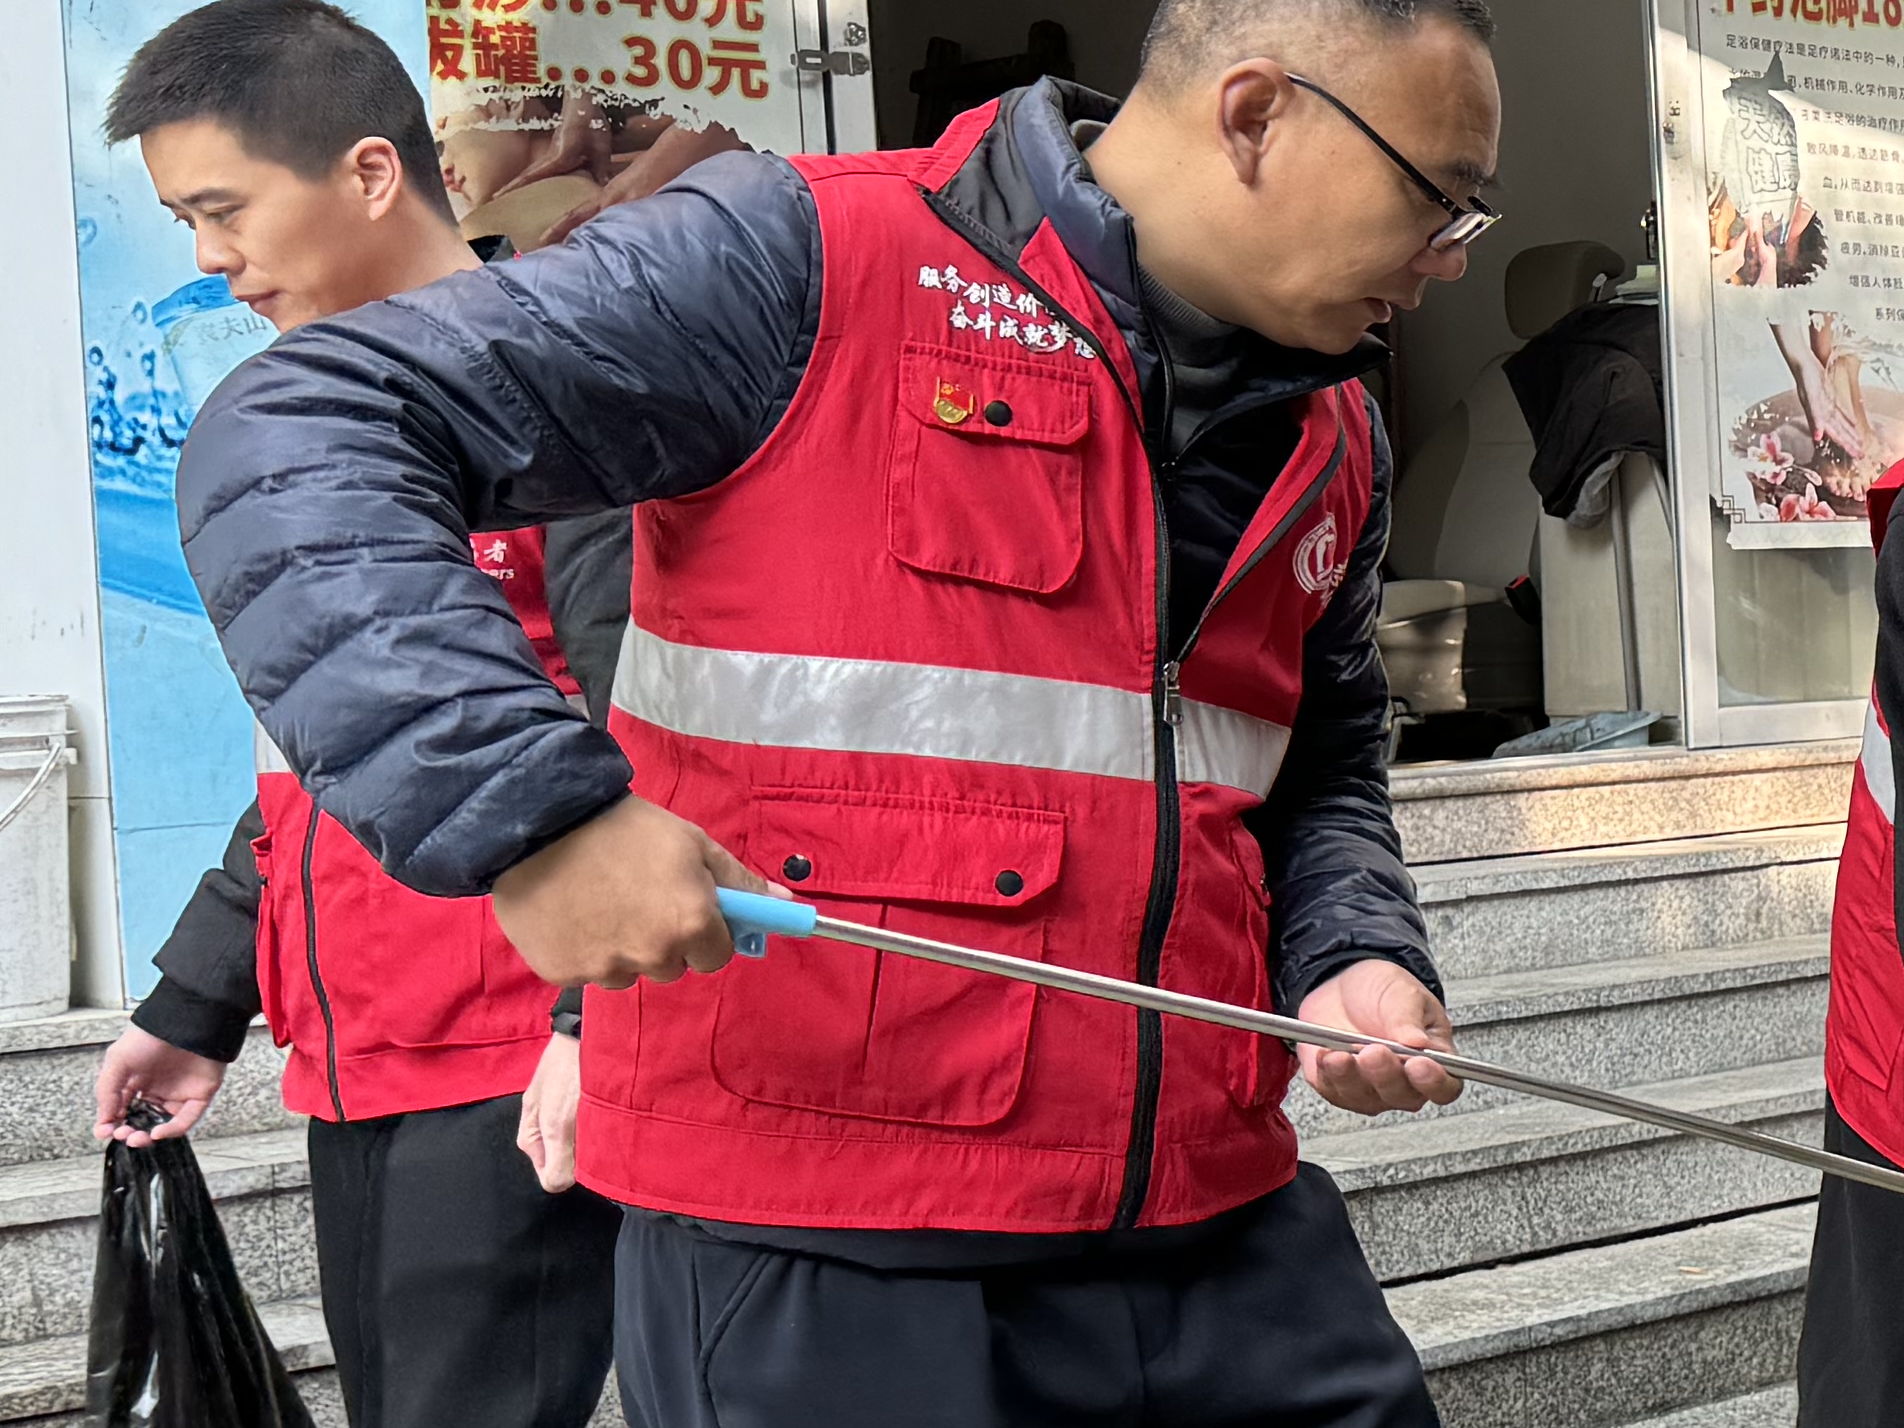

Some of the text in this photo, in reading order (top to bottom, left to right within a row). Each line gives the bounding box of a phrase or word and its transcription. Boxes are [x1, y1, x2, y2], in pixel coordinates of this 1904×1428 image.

[918, 264, 1056, 319] 服务创造价
